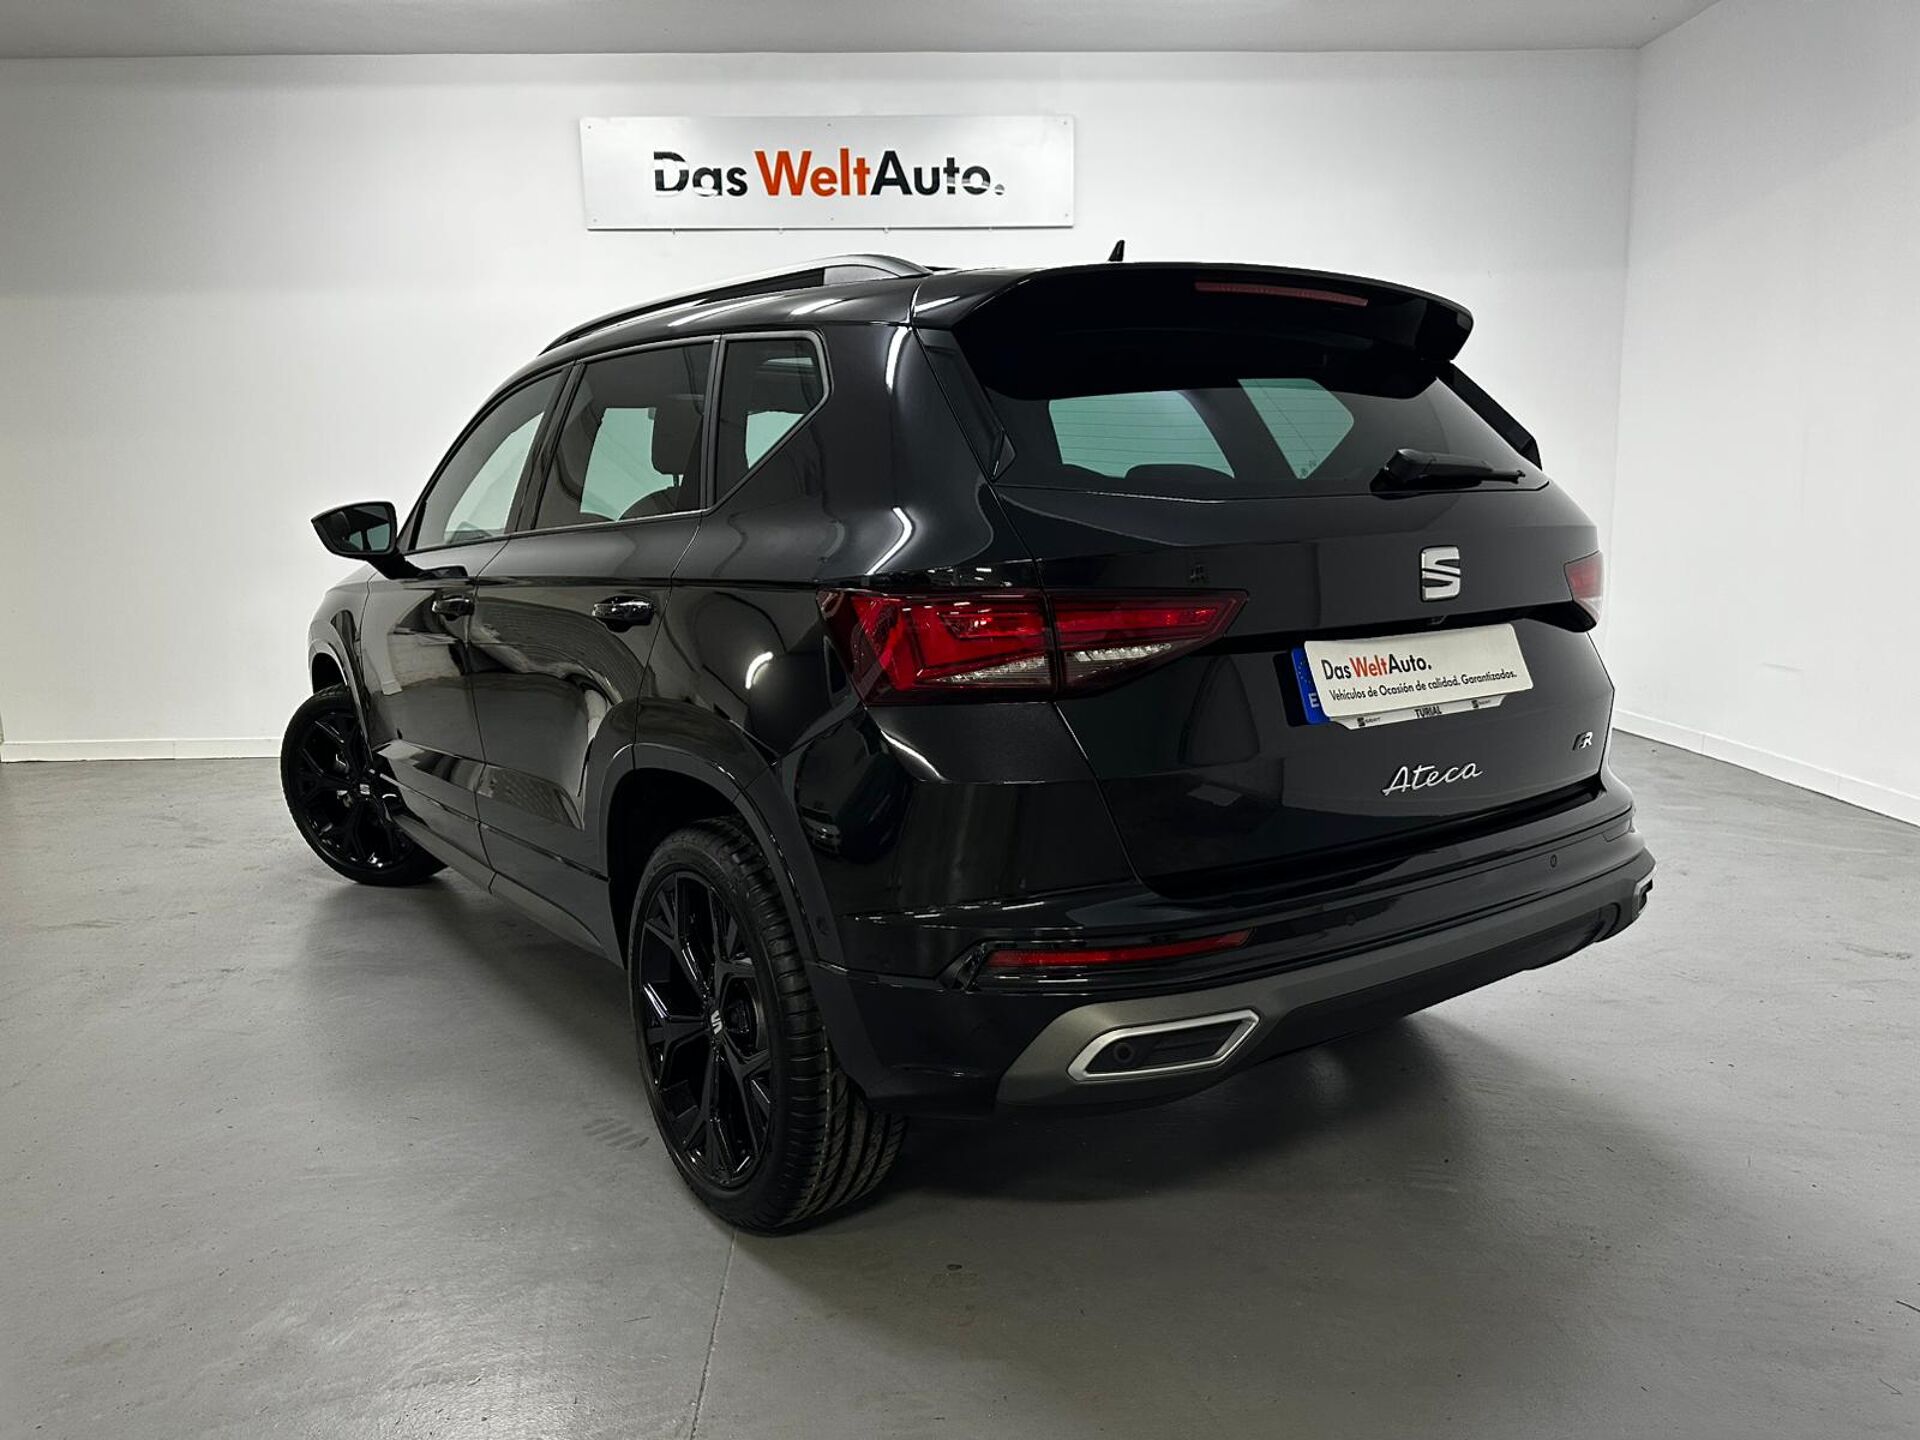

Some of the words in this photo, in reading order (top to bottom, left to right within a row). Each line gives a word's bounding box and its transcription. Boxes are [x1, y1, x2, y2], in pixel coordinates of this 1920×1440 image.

[653, 151, 748, 197] Das
[755, 147, 1005, 197] WeltAuto.
[1321, 659, 1351, 680] Das
[1367, 686, 1378, 697] de
[1379, 683, 1414, 696] Ocasión
[1415, 680, 1426, 691] de
[1308, 692, 1320, 708] E
[1414, 705, 1442, 718] TURIAL
[1381, 762, 1483, 796] Ateca
